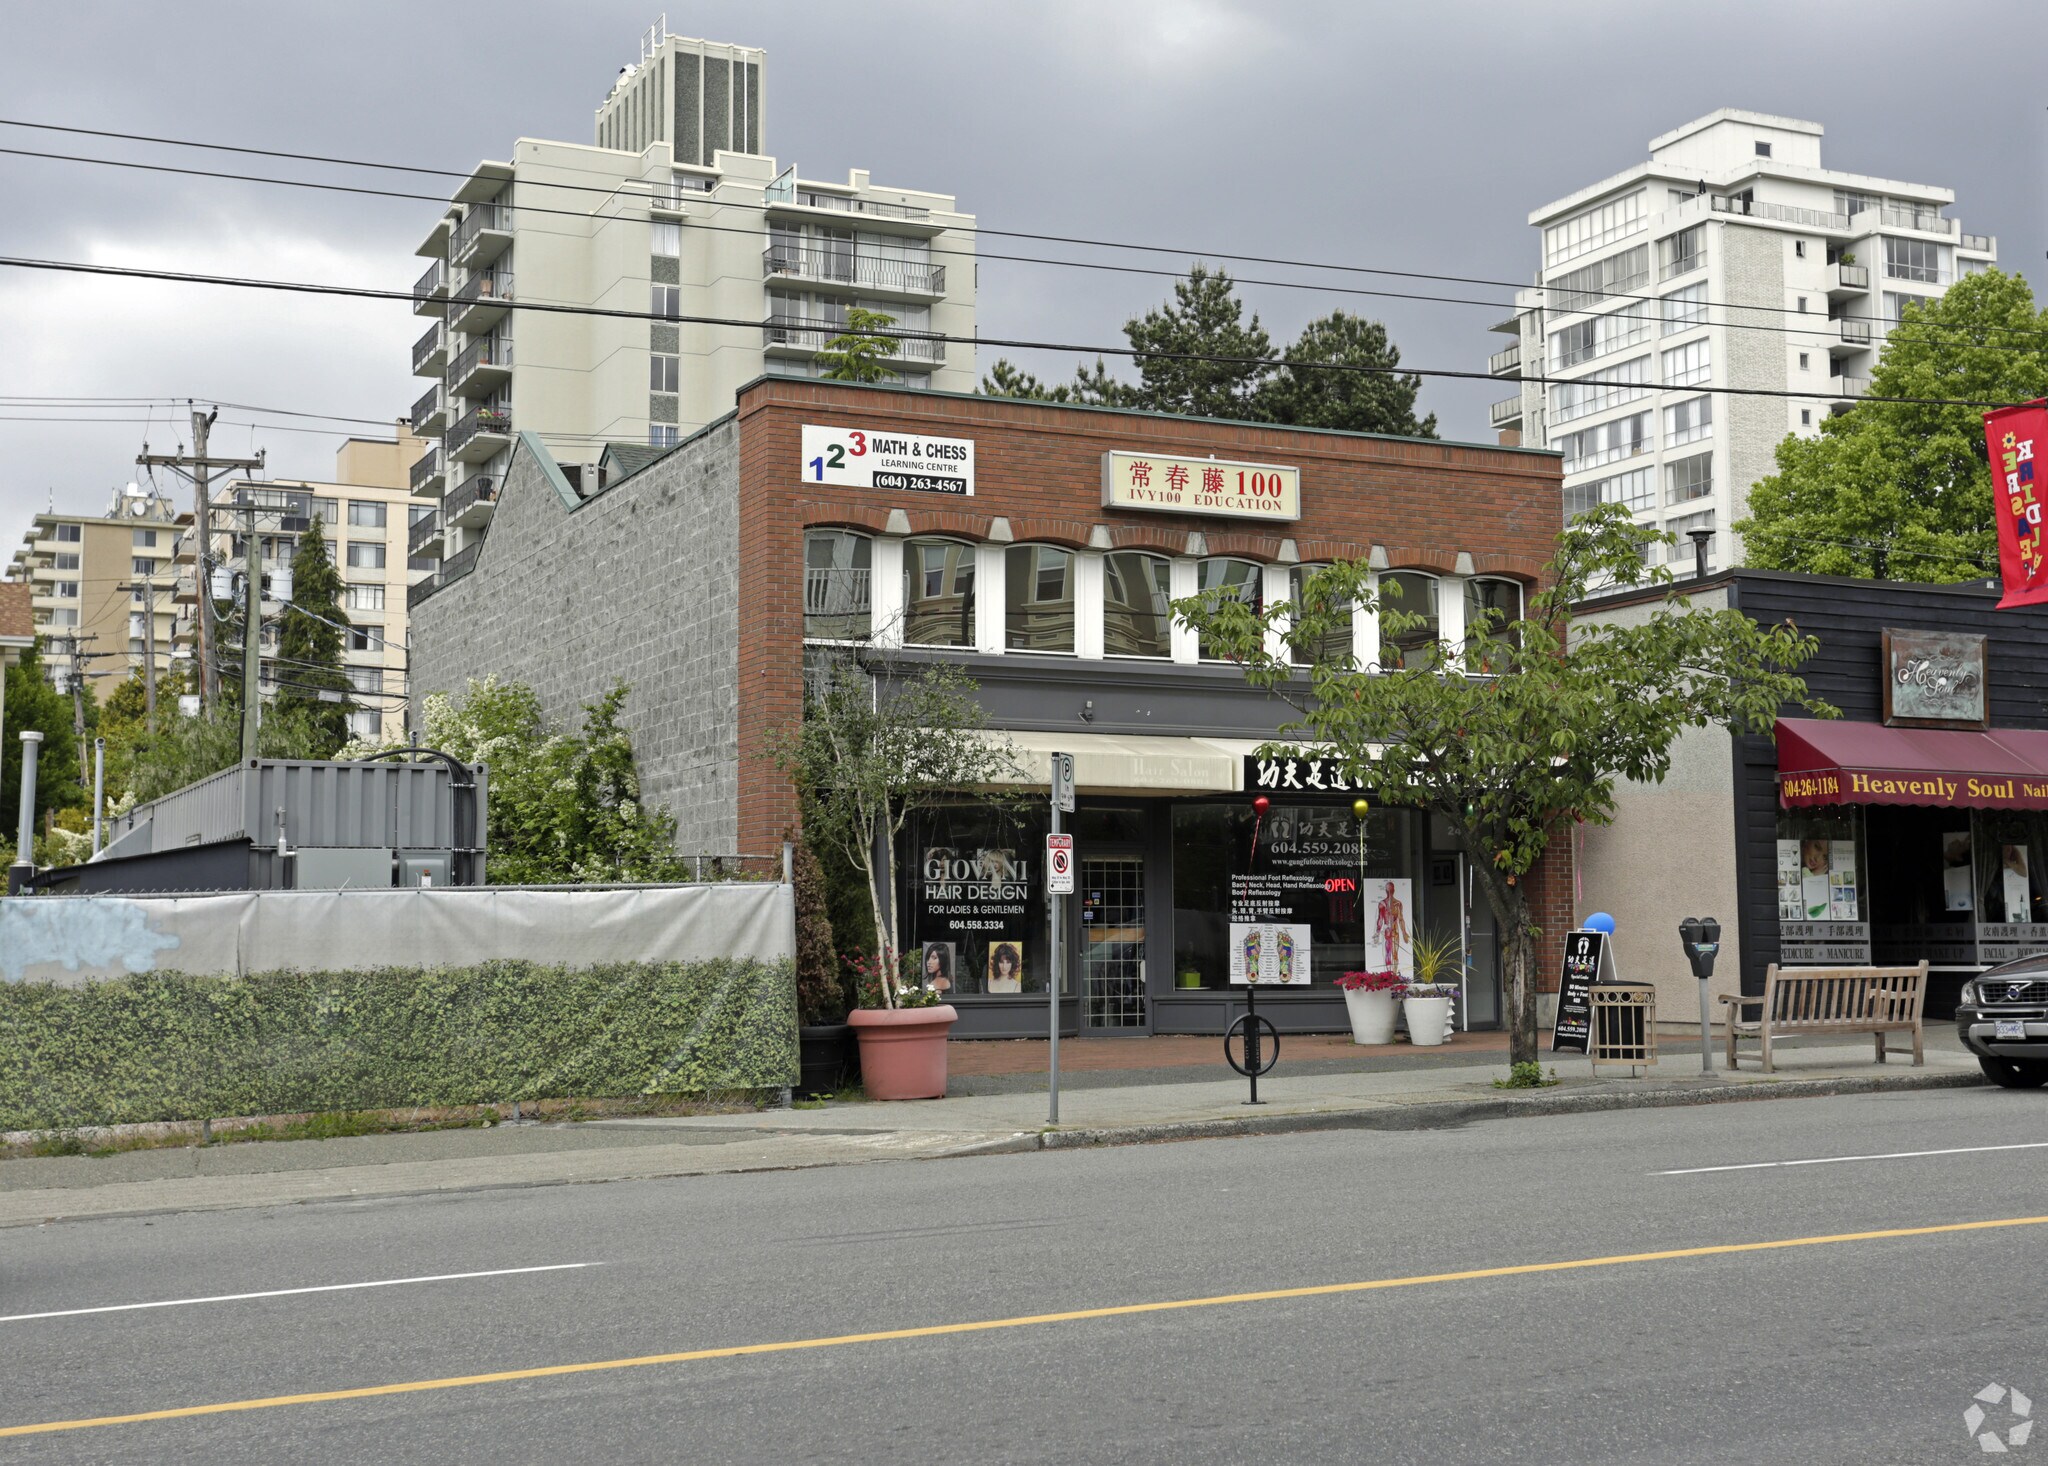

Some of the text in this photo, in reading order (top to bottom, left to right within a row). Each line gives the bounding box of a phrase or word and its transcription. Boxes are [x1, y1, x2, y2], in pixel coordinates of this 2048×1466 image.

[872, 438, 967, 461] MATH & CHESS
[881, 458, 959, 473] LEARNING CENTRE
[876, 474, 964, 493] (604) 263-4567
[1129, 488, 1282, 511] IVY100 EDUCATION
[1898, 660, 1972, 684] Heavenly
[1924, 677, 1959, 697] Soul
[1134, 758, 1209, 777] Hair Salon
[1784, 777, 1839, 798] 604-264-1184
[1851, 773, 1958, 801] Heavenly
[1967, 778, 2015, 799] Soul
[1298, 821, 1370, 839] 功夫足道
[1271, 842, 1368, 855] 604.559.2088
[924, 859, 1028, 881] GIOVANI
[1281, 874, 1315, 883] Reflexology
[1324, 878, 1356, 893] OPEN
[925, 885, 1028, 900] HAIR DESIGN
[1231, 889, 1282, 898] Body Reflexology
[928, 905, 1025, 915] FOR LADIES & GENTLEMEN
[949, 920, 1004, 930] 604.558.3334
[1780, 948, 1814, 959] PEDICURE
[1827, 948, 1864, 959] MANICURE
[1983, 948, 2008, 959] FACIAL
